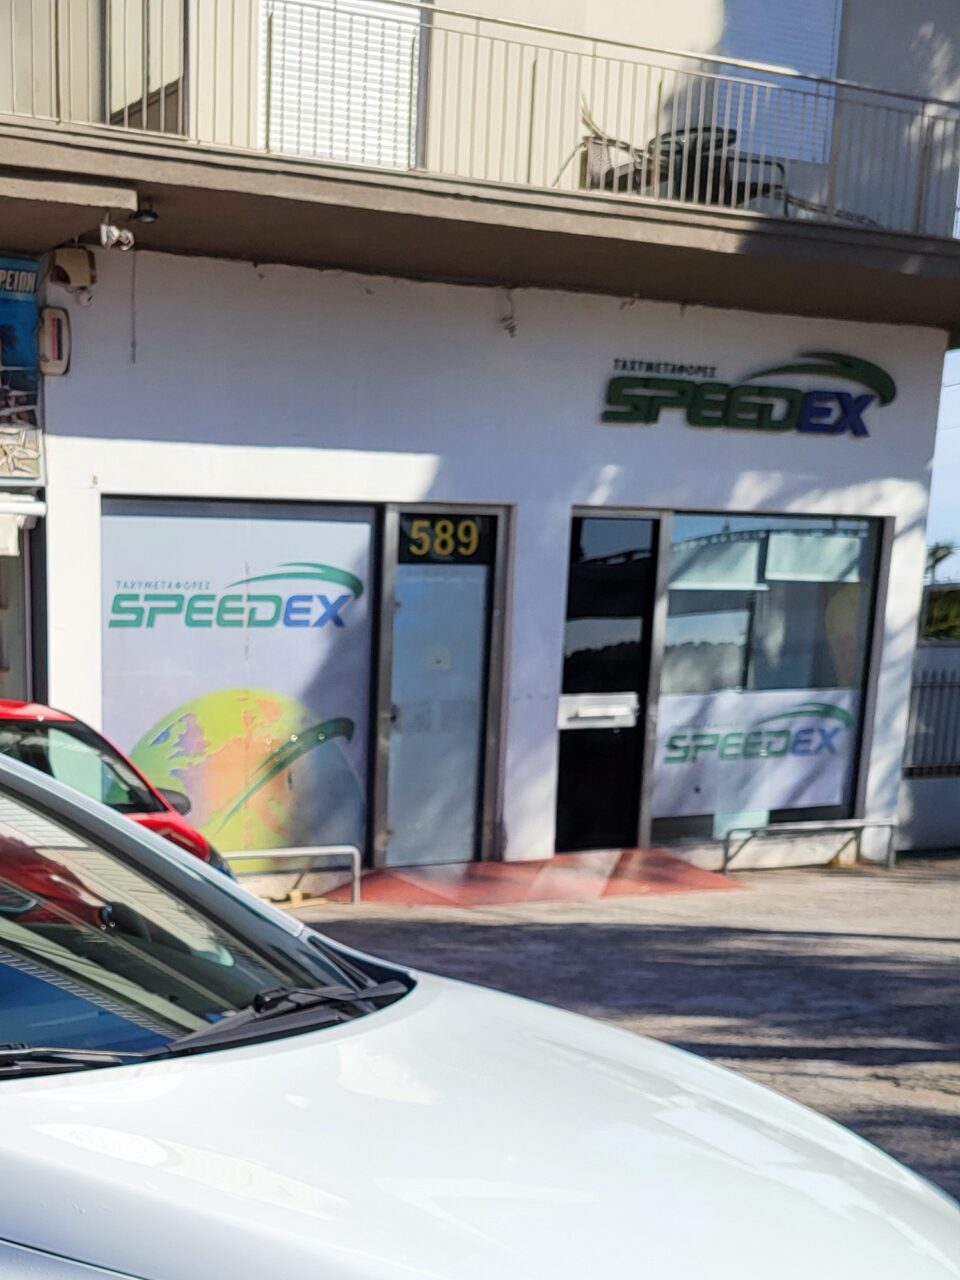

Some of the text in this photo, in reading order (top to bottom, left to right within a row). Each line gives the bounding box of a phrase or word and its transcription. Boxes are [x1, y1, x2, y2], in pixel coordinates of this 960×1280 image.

[601, 376, 876, 438] SPEEDEX
[408, 520, 480, 557] 589
[108, 594, 352, 629] SPEEDEX
[663, 727, 840, 764] SPEEDEX
